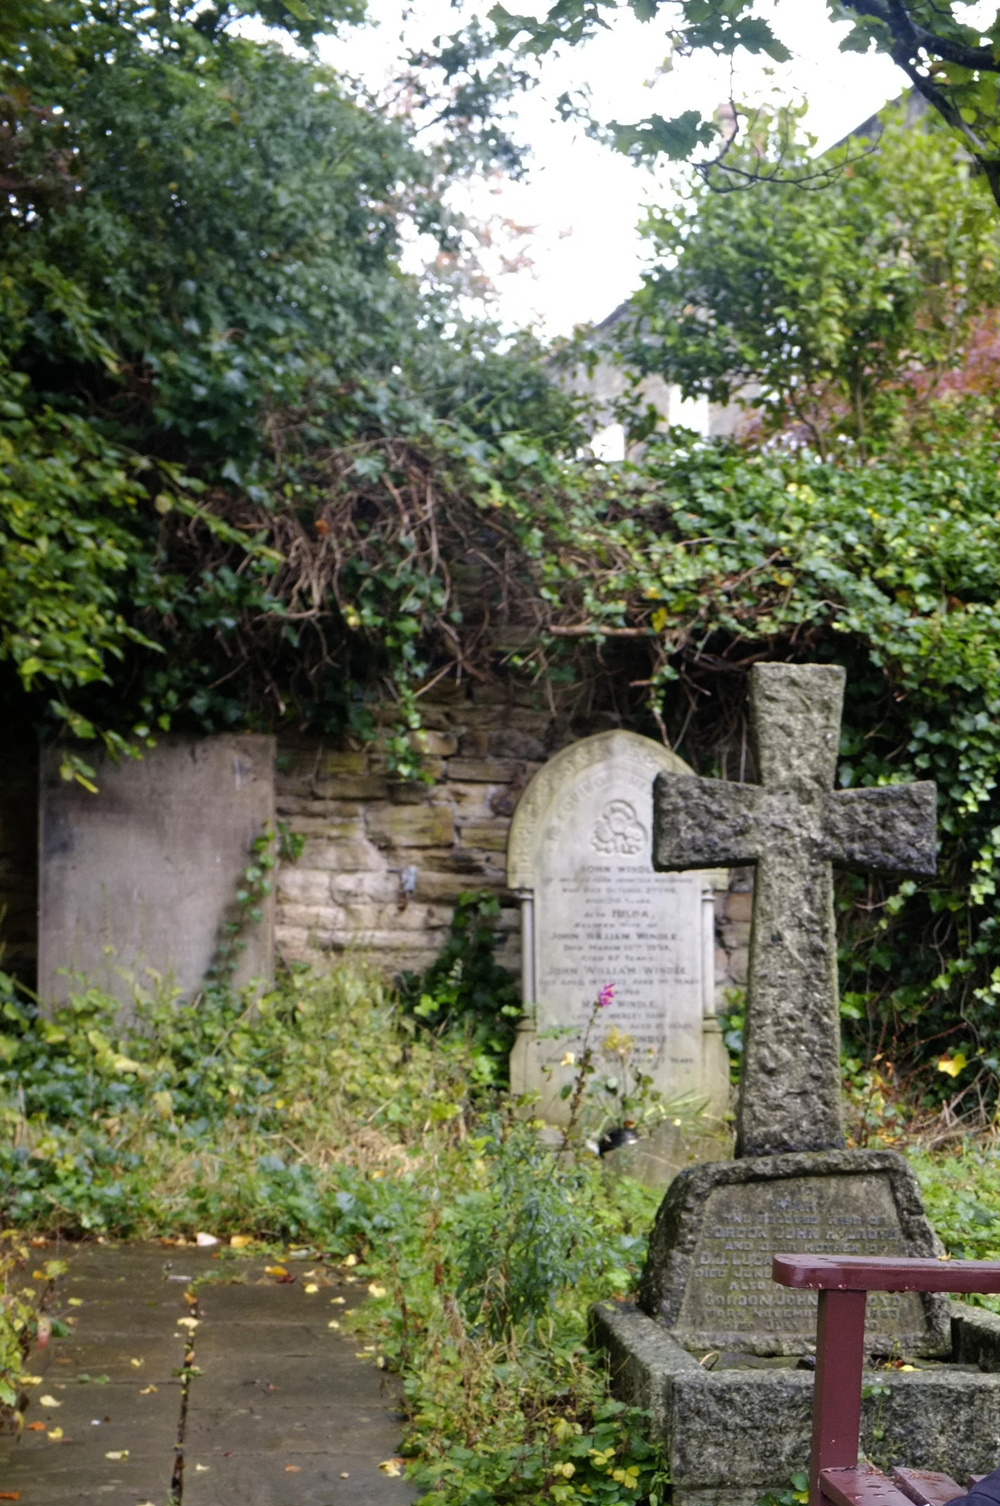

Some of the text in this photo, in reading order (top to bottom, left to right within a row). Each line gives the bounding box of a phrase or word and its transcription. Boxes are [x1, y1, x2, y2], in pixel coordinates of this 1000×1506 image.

[616, 865, 652, 873] WINDL
[551, 932, 579, 940] JOHN
[548, 965, 578, 975] JOHN
[584, 965, 636, 975] WILLIAM
[703, 1226, 768, 1240] GORDON
[773, 1226, 820, 1240] JOHN
[725, 1242, 754, 1252] AND
[804, 1243, 861, 1253] MOTHER
[731, 1252, 773, 1266] LUCA
[695, 1269, 726, 1279] DIED
[729, 1280, 766, 1291] ALSO
[704, 1294, 772, 1307] GORDON
[774, 1294, 818, 1307] JOHN
[753, 1308, 818, 1320] NOVEMB
